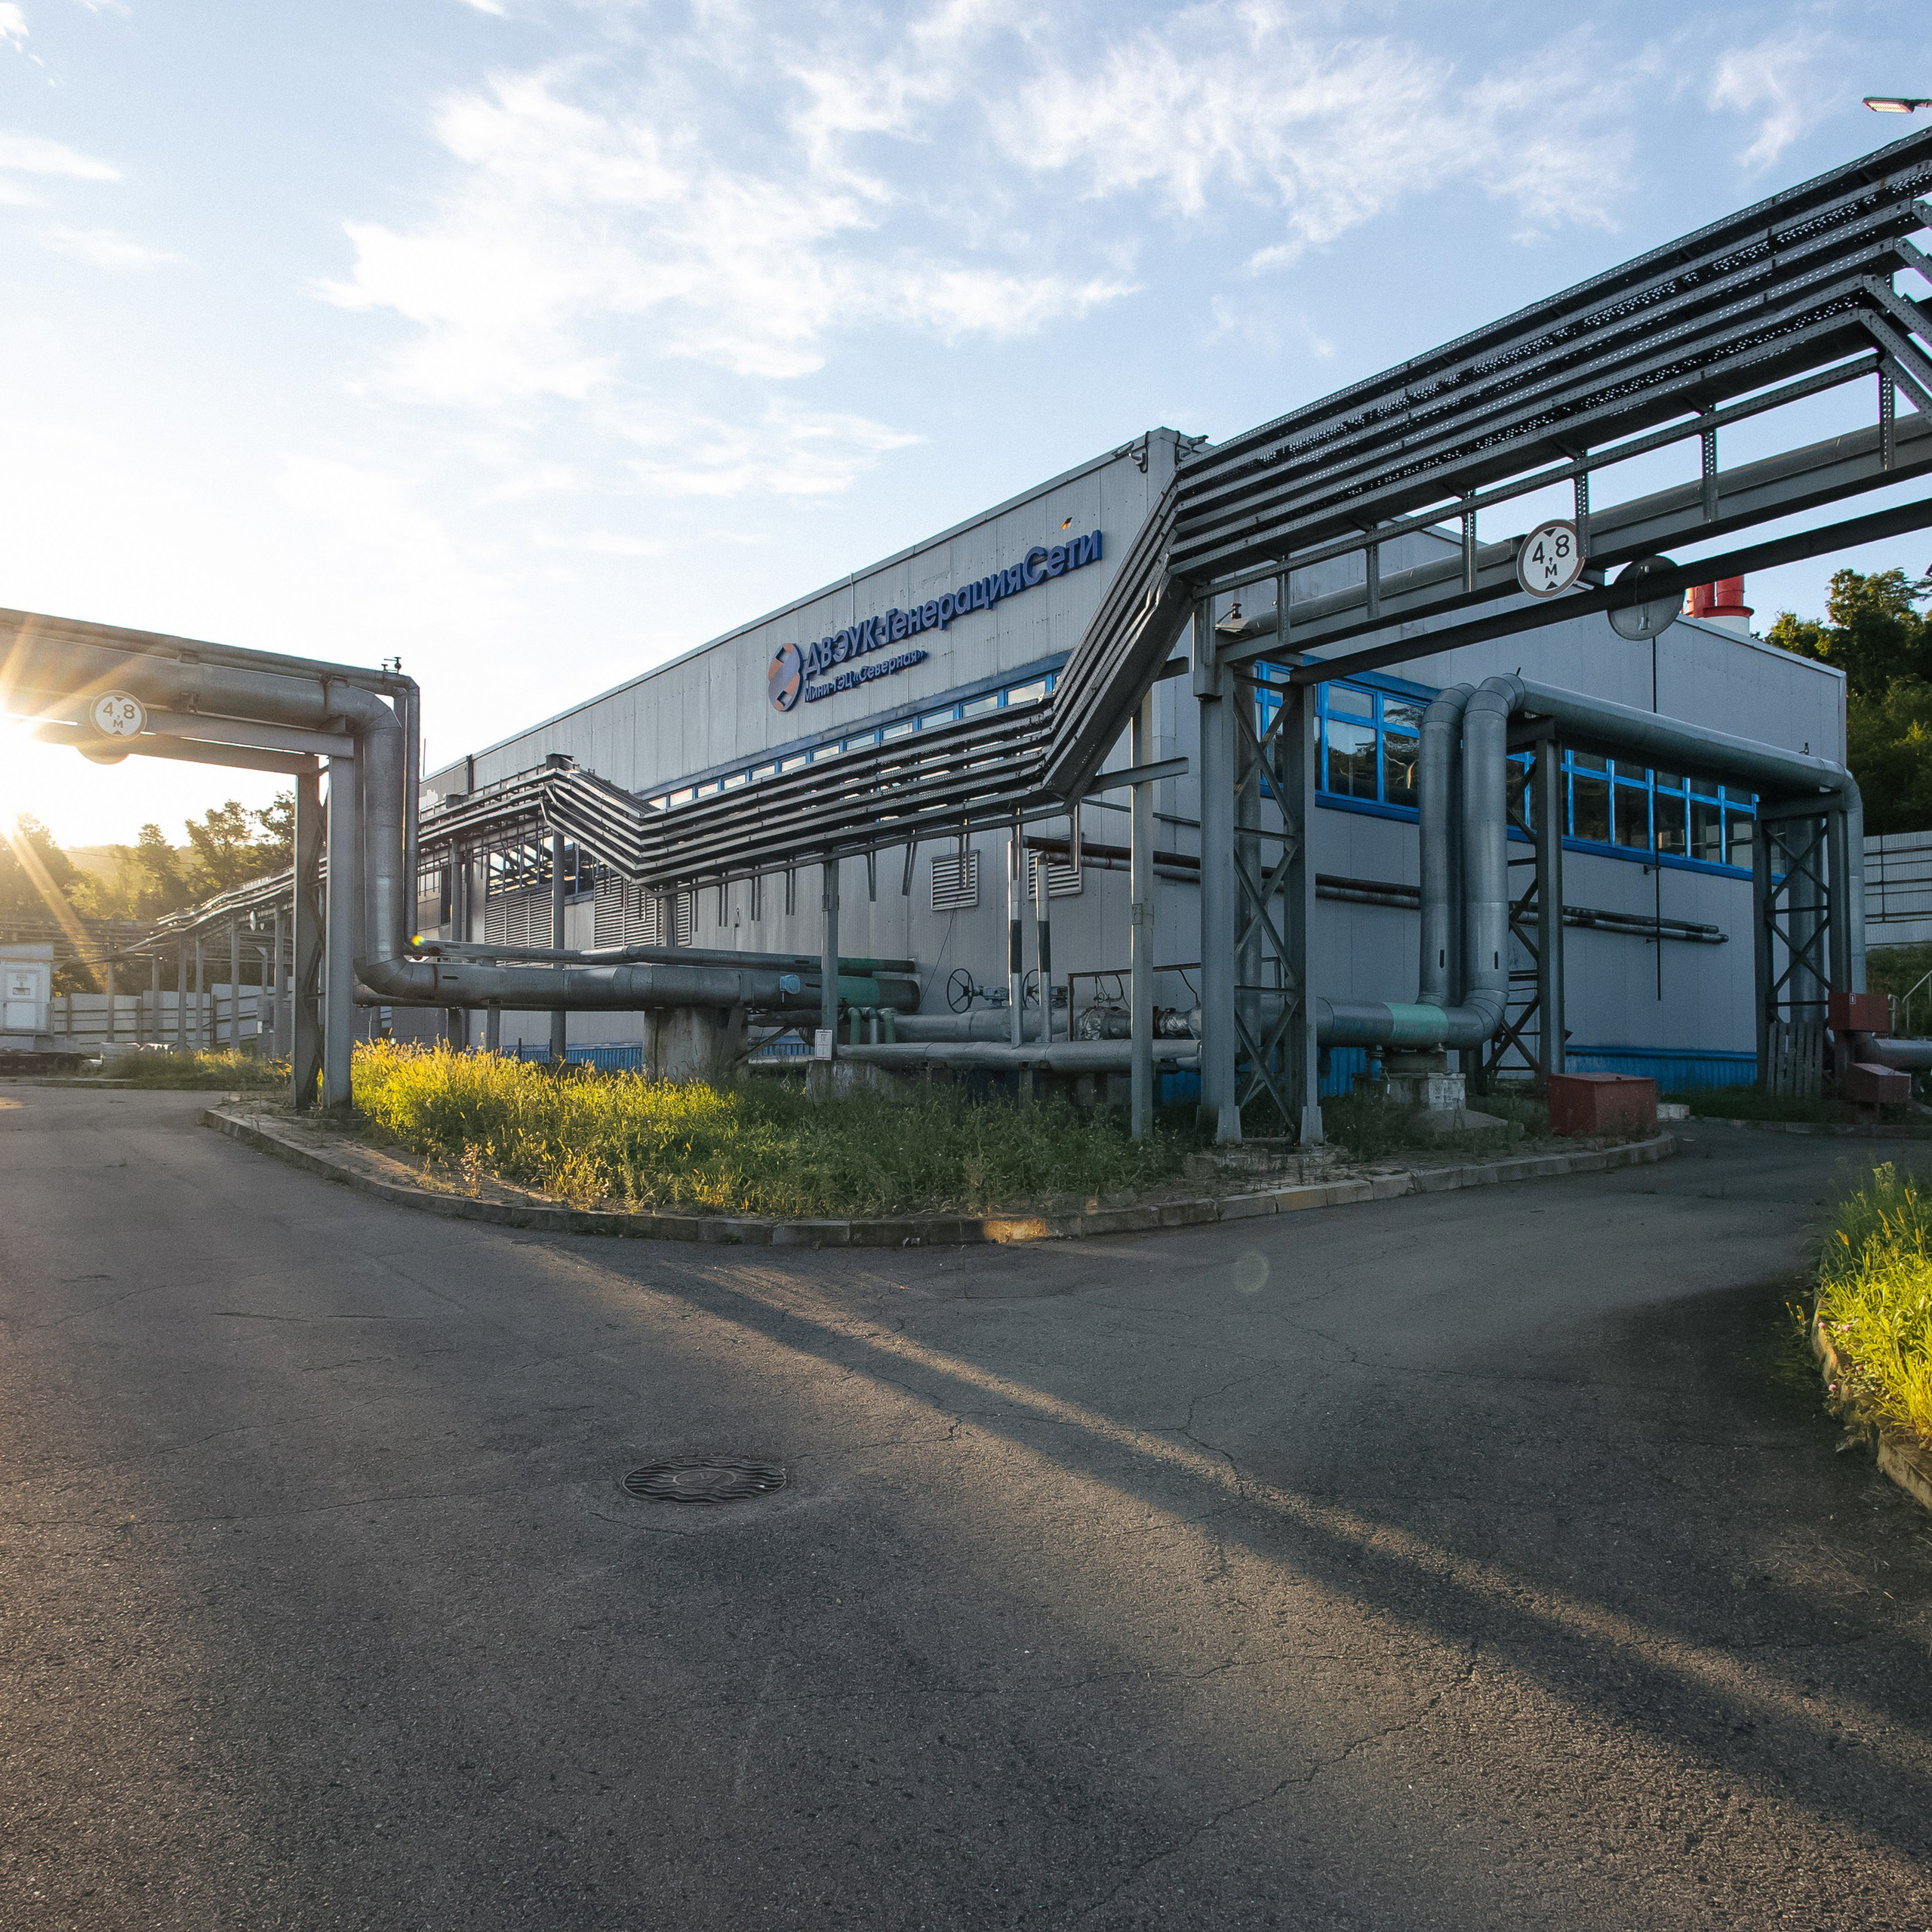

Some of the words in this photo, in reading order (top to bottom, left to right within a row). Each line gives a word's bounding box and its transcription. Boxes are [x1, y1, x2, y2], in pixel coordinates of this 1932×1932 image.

[1532, 534, 1570, 565] 4,8
[804, 530, 1102, 679] ДВЭУК-ГенерацияСети
[853, 649, 928, 686] «Северная»
[103, 702, 135, 719] 4,8
